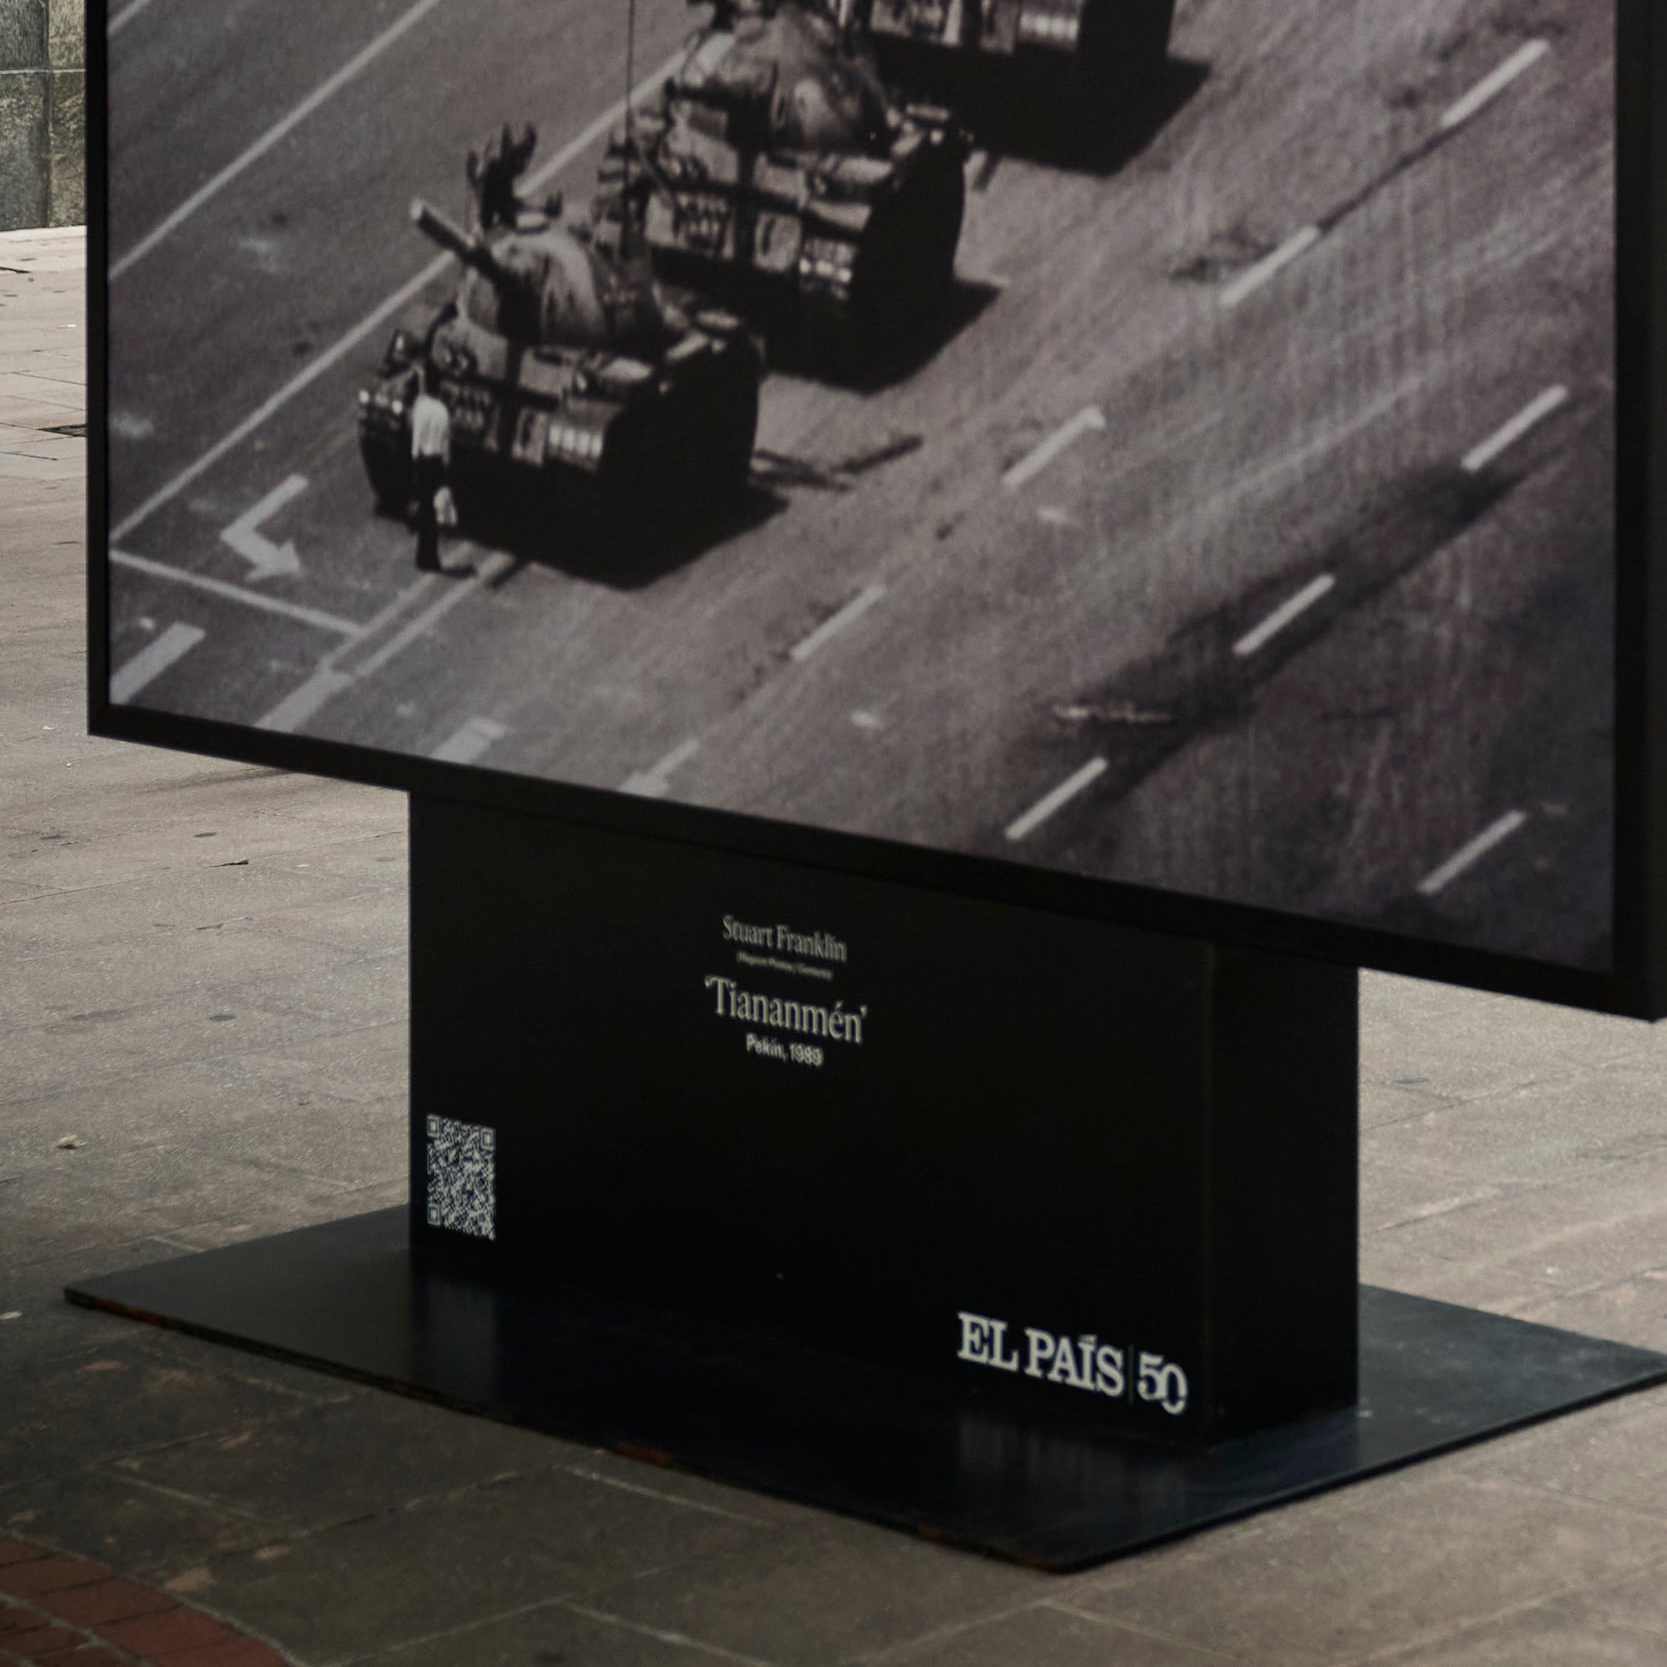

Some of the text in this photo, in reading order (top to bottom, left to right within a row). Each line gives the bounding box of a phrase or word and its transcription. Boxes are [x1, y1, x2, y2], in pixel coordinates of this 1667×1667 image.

[722, 914, 848, 963] Stuart Franklin
[745, 1033, 825, 1068] Pekín, 1989
[957, 1310, 1188, 1416] EL PAÍS 50
